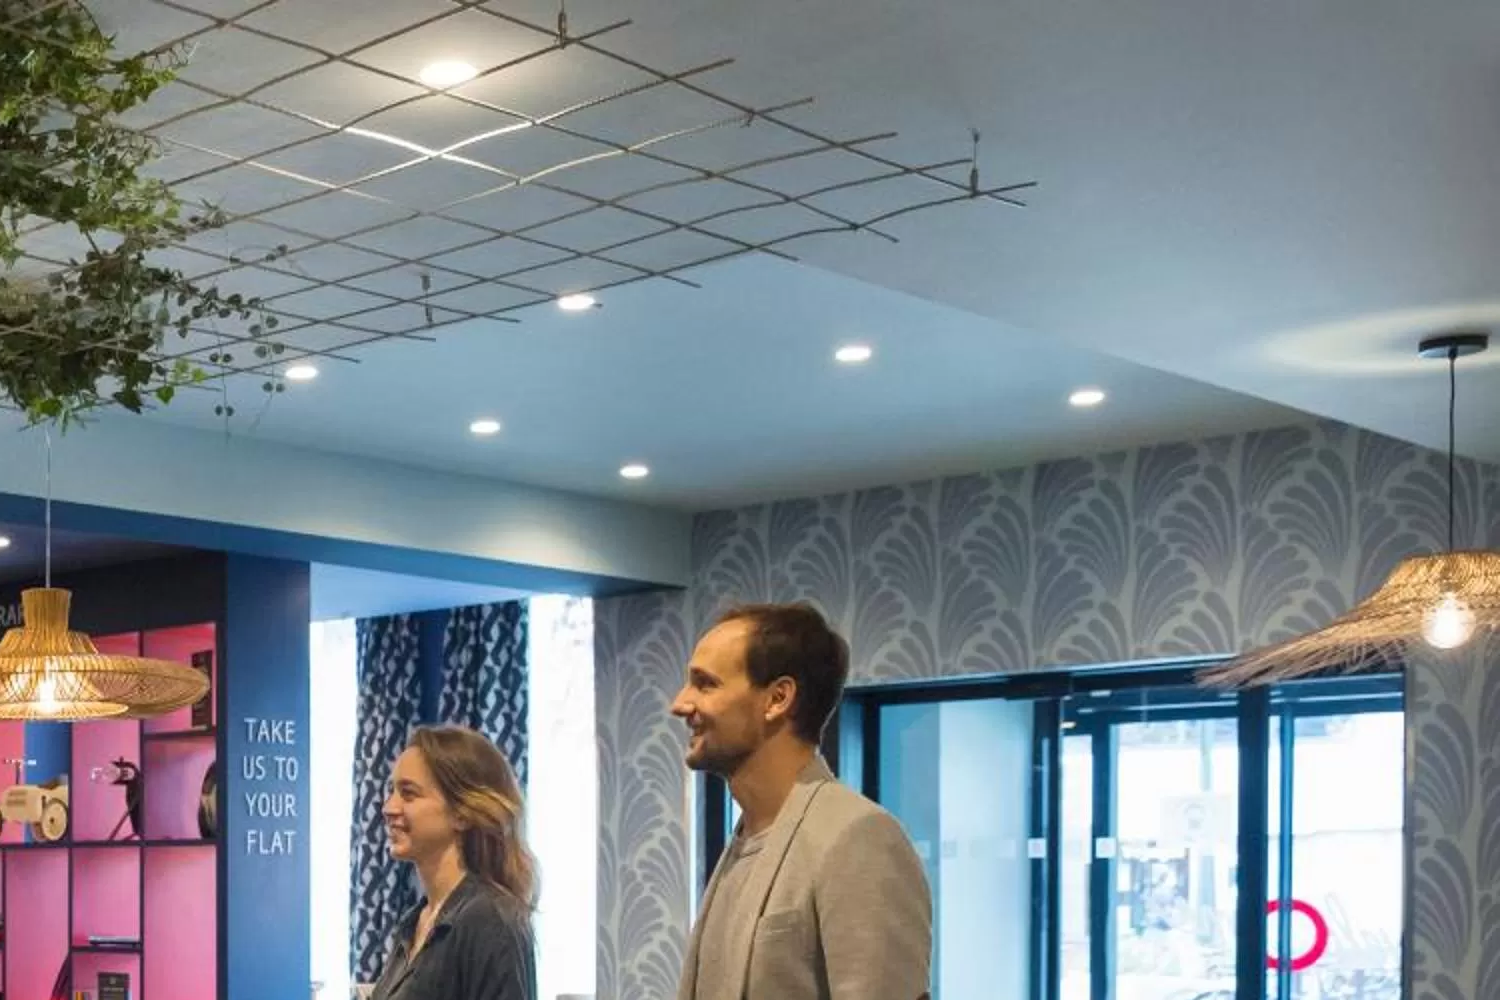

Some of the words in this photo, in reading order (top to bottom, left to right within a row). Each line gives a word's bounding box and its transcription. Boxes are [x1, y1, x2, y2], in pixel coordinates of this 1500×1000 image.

[244, 717, 296, 744] TAKE
[243, 755, 266, 781] US
[274, 756, 299, 781] TO
[245, 792, 297, 817] YOUR
[247, 829, 297, 855] FLAT
